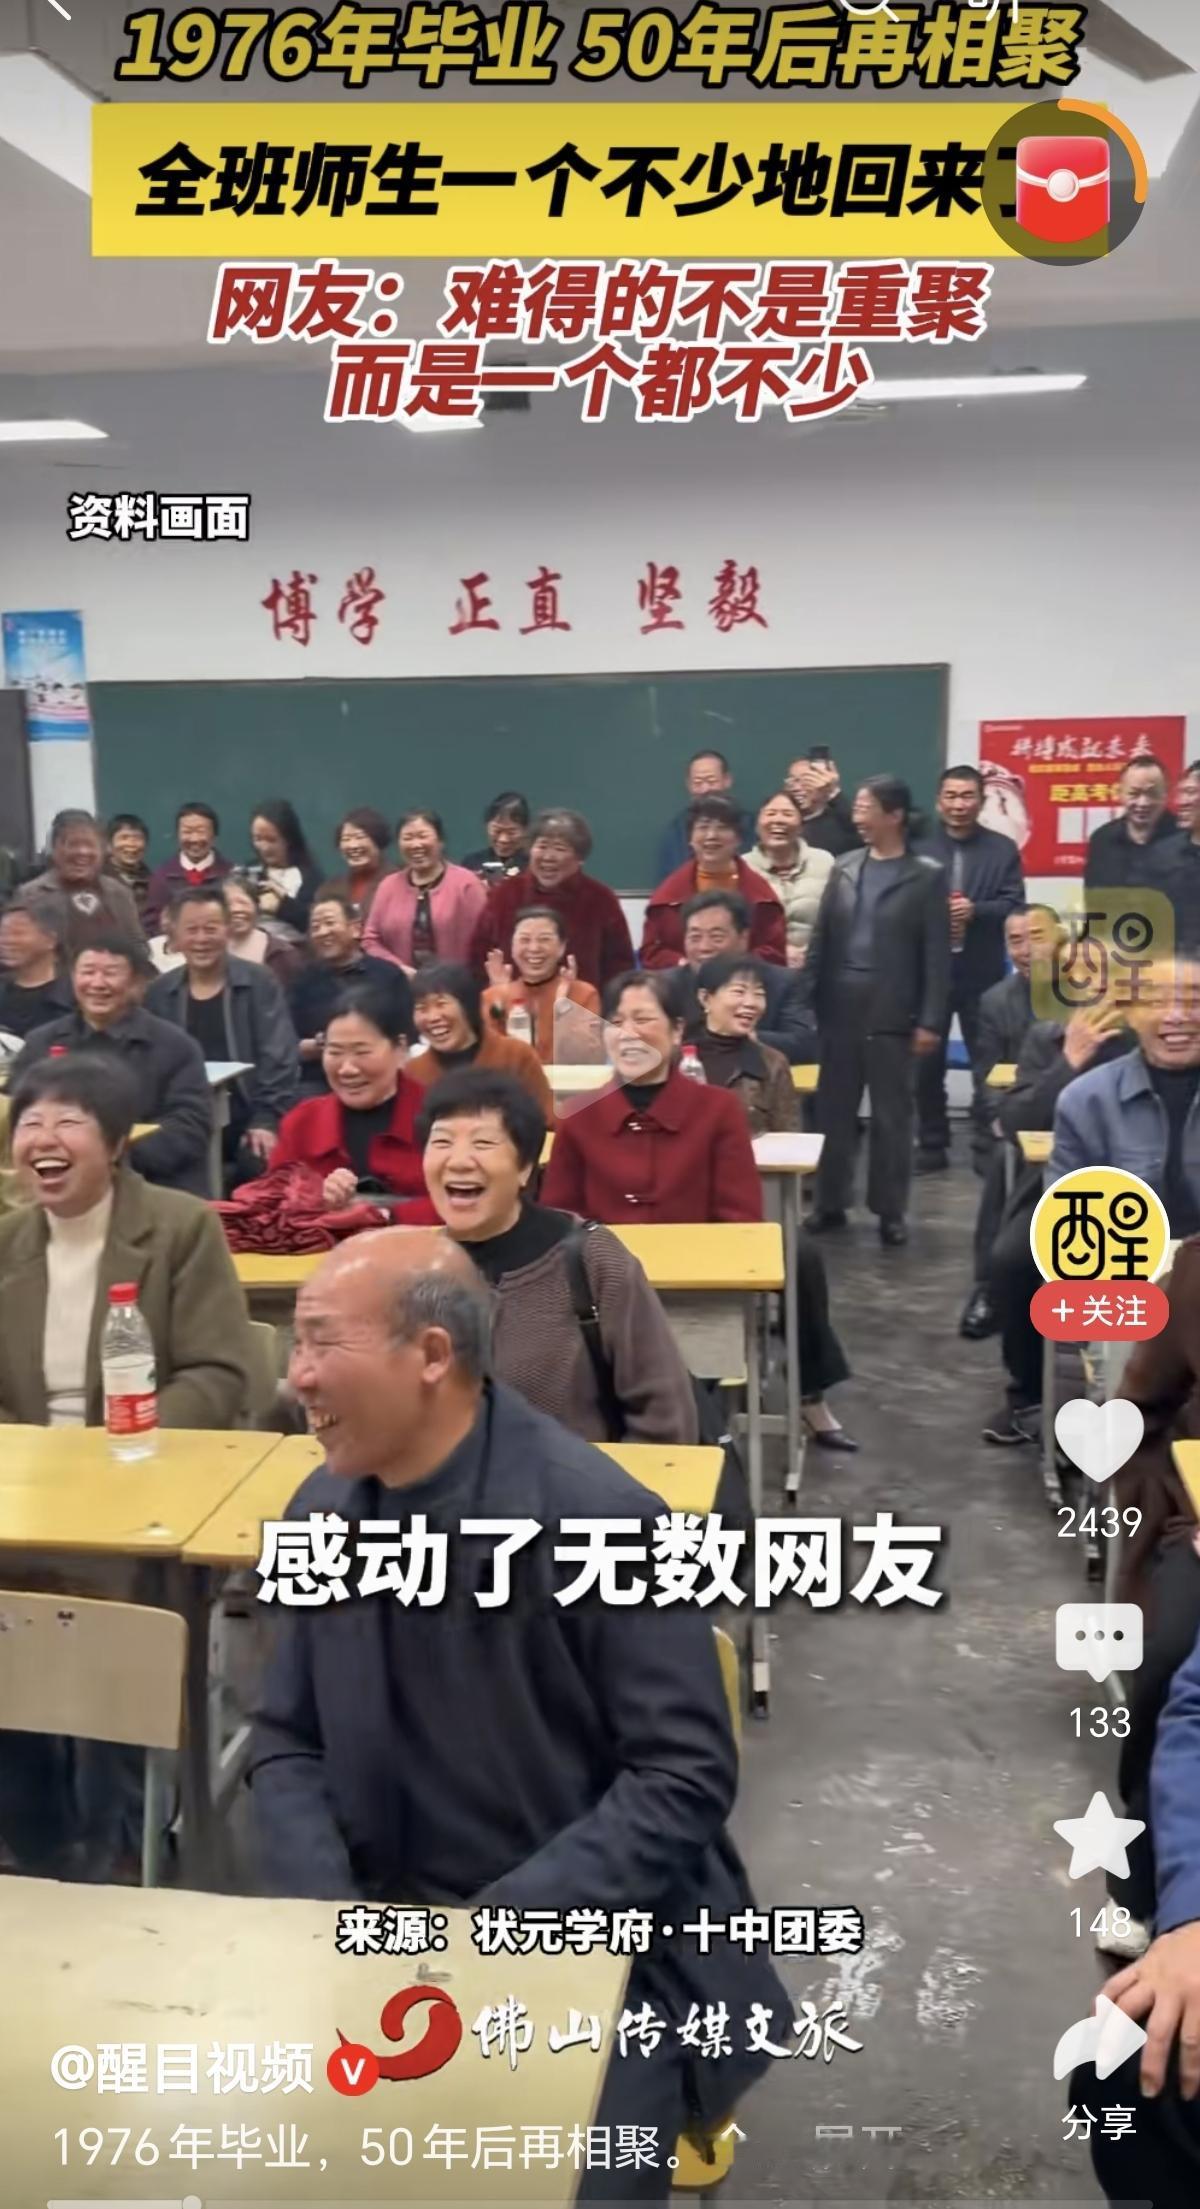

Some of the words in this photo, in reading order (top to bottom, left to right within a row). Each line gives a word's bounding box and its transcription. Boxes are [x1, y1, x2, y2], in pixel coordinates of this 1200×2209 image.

[261, 568, 386, 646] 博学
[448, 566, 571, 635] 正直
[637, 559, 768, 634] 坚毅
